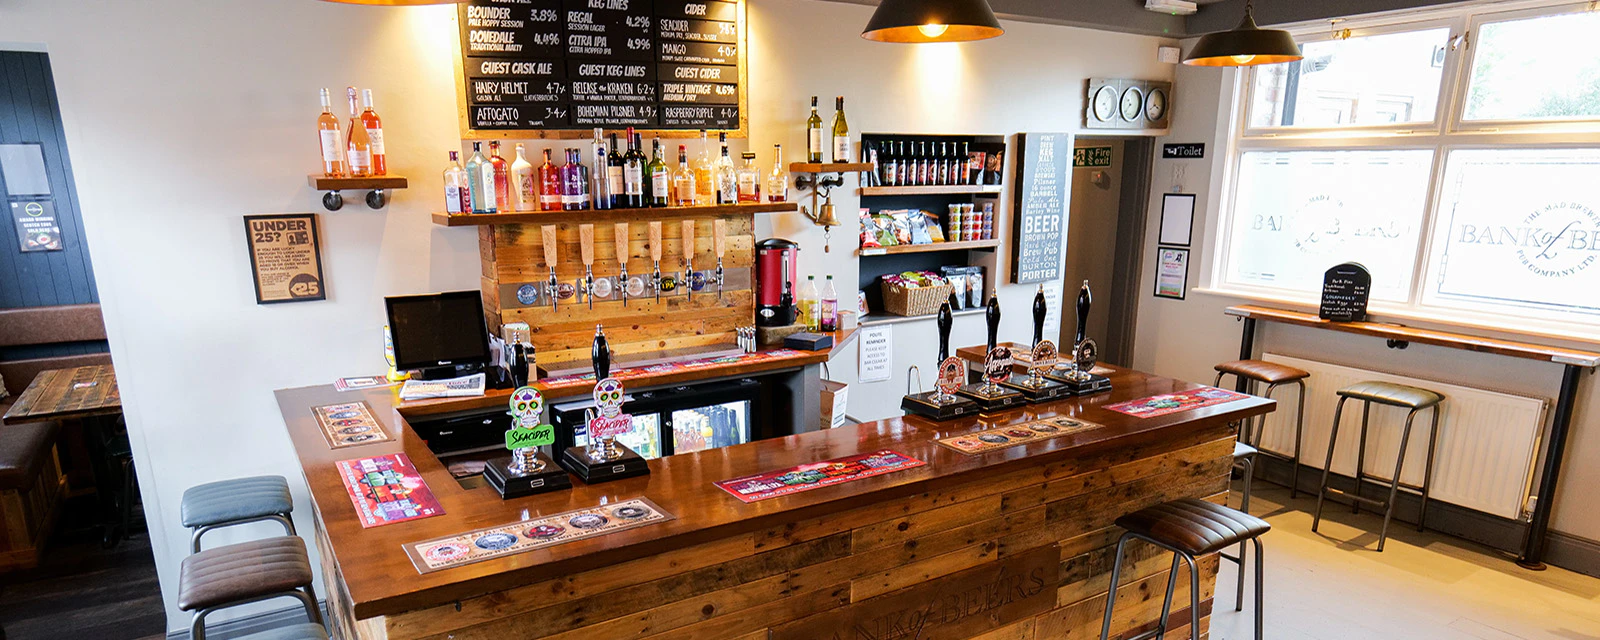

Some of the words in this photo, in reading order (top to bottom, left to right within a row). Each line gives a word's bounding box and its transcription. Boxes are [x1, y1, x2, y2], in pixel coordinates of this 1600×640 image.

[606, 0, 629, 11] LINES
[685, 3, 706, 15] CIDER
[468, 6, 510, 19] BOUNDER
[530, 9, 557, 22] 3.8%
[567, 11, 593, 24] REGAL
[626, 15, 650, 28] 4.2%
[590, 24, 606, 32] LAGER
[660, 19, 689, 32] SEACIDER
[470, 30, 515, 43] DOVEDALE
[534, 33, 560, 45] 4.4%
[568, 34, 592, 46] CITRA
[594, 36, 607, 47] IPA
[627, 38, 651, 50] 4.9%
[505, 44, 523, 52] MALTY
[662, 43, 686, 55] MANGO
[481, 61, 510, 74] GUEST
[512, 63, 536, 75] CASK
[537, 63, 552, 75] ALE
[579, 64, 605, 76] GUEST
[606, 65, 623, 77] KEG
[624, 66, 646, 77] LINES
[675, 67, 699, 79] GUEST
[699, 68, 721, 79] CIDER
[475, 82, 499, 94] HAIRY
[501, 82, 528, 94] HELMET
[573, 82, 598, 94] RELEASE
[607, 83, 634, 94] KRAKEN
[663, 83, 684, 94] TRIPLE
[685, 84, 711, 95] VINTAGE
[477, 108, 519, 121] AFFOGATO
[577, 105, 609, 117] BOHEMIAN
[610, 106, 636, 117] PILSNER
[665, 107, 695, 118] RASPBERRY
[696, 108, 714, 119] RIPPLE
[1039, 148, 1054, 156] KEG
[1095, 148, 1110, 156] Fire
[1177, 146, 1202, 156] Toilet
[1094, 156, 1110, 165] exit
[1523, 210, 1541, 225] THE
[1544, 202, 1566, 213] MAD
[252, 220, 307, 232] UNDER
[1025, 214, 1059, 234] BEER
[255, 232, 282, 243] 25?
[1024, 233, 1046, 242] BROWN
[1046, 232, 1058, 240] POP
[1459, 224, 1543, 248] BANK
[1023, 248, 1042, 257] Brew
[1043, 246, 1058, 255] Pub
[1022, 261, 1057, 270] BURTON
[1517, 249, 1529, 265] PUB
[1528, 263, 1575, 278] COMPANY
[1022, 269, 1056, 281] PORTER
[511, 428, 551, 446] SEACIDER
[940, 567, 1045, 626] BEERS
